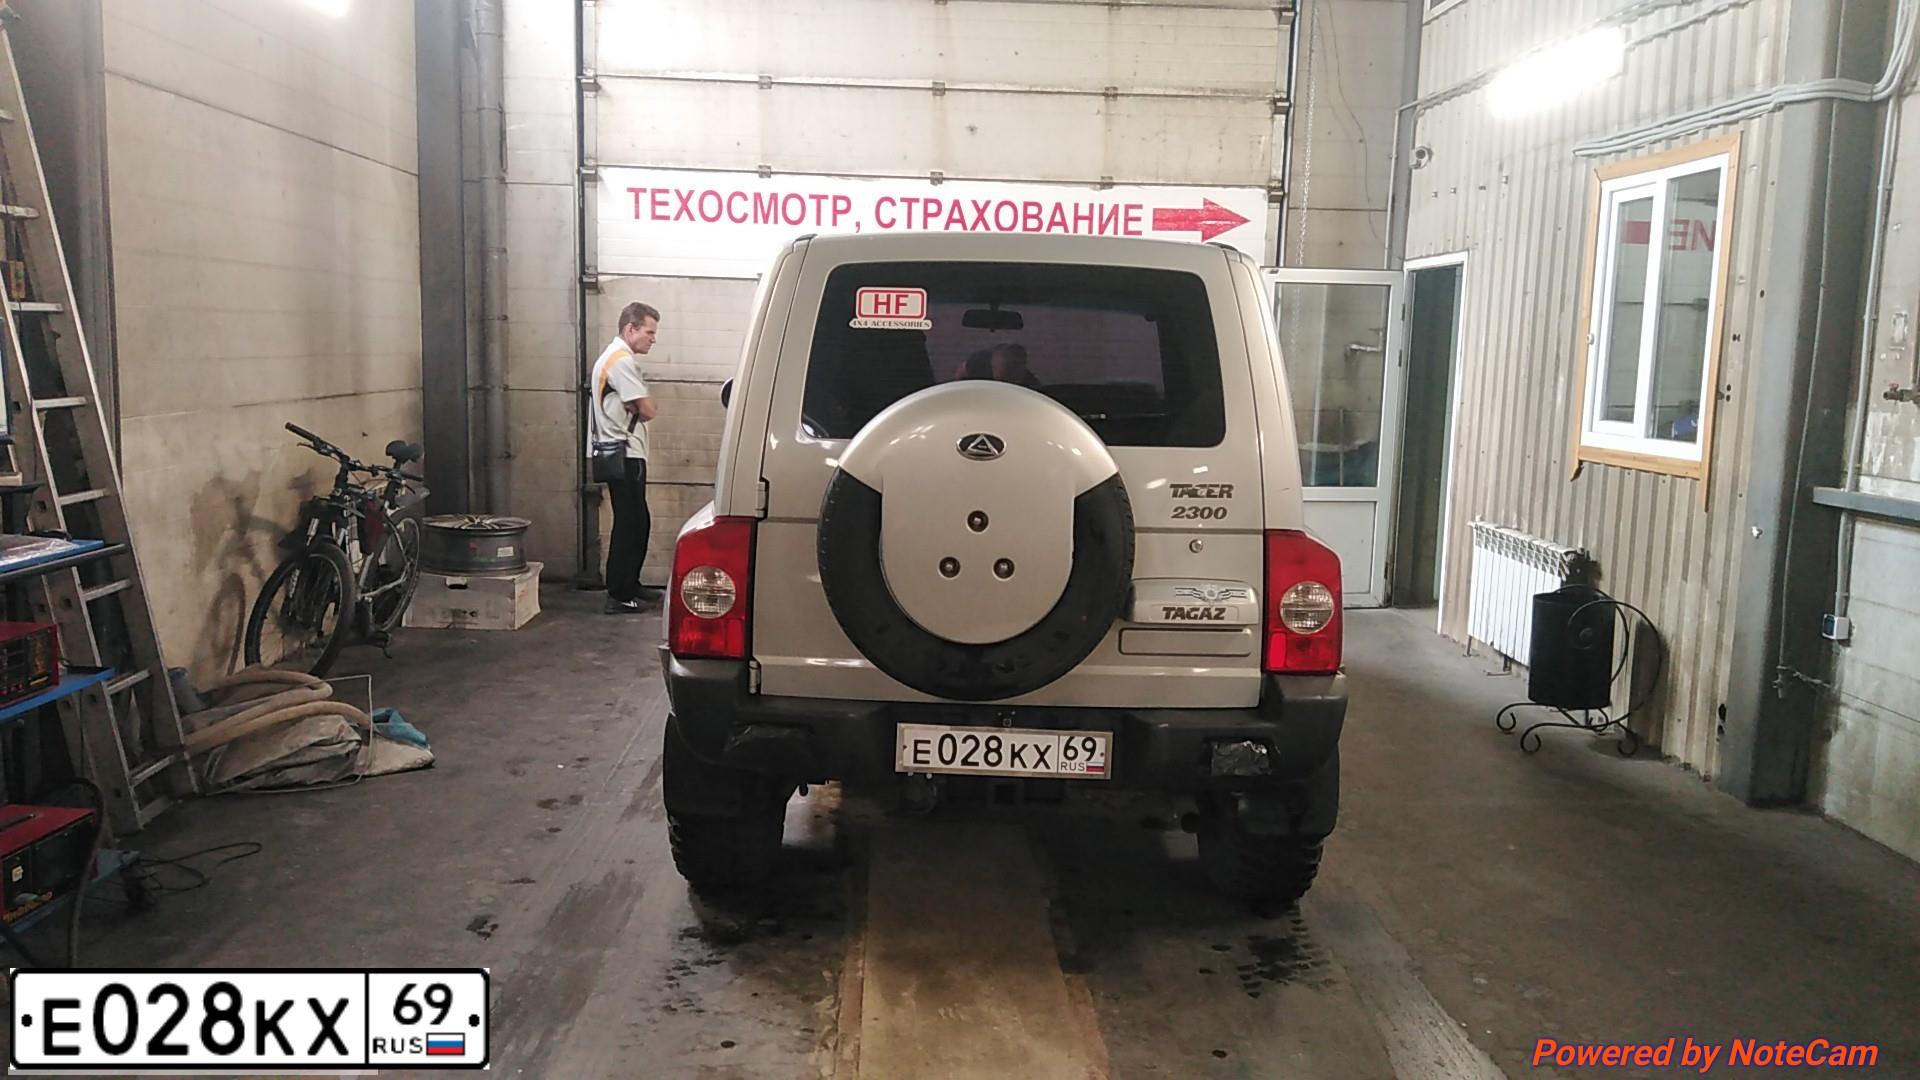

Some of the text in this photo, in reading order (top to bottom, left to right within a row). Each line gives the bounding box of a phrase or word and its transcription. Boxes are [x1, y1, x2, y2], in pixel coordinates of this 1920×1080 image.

[626, 187, 1144, 236] ТЕХОСМОТР, СТРАХОВАНИЕ
[873, 293, 909, 314] HF
[871, 320, 930, 328] ACCESSORIES
[1171, 506, 1227, 519] 2300
[1163, 607, 1225, 620] TAGAZ
[1062, 735, 1098, 762] 69
[1060, 762, 1086, 772] RUS
